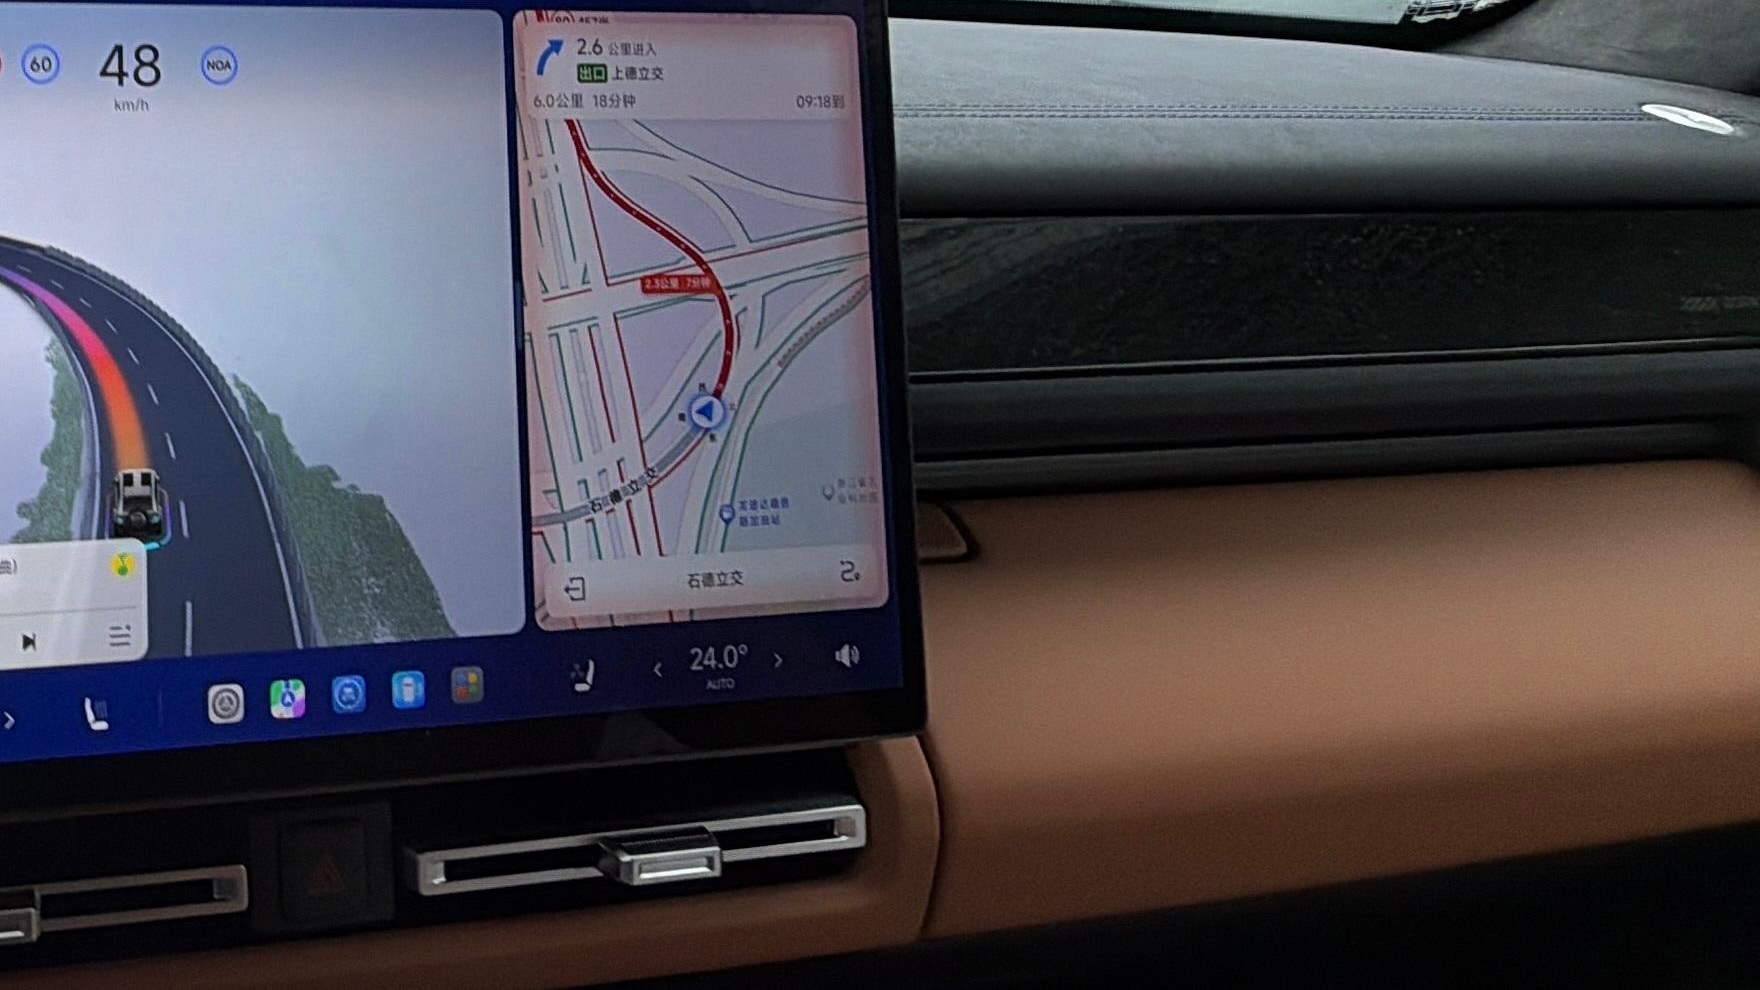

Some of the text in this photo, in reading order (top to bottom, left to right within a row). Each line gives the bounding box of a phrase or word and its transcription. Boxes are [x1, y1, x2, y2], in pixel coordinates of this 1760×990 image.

[576, 38, 657, 57] 2.6 公里进入
[29, 56, 53, 73] 60
[98, 43, 162, 87] 48
[206, 59, 232, 72] NOA
[578, 65, 664, 81] 出口 上德立交
[113, 97, 150, 114] km/h
[533, 94, 636, 109] 6.0公里 18分钟
[687, 570, 744, 590] 石德立交
[690, 644, 748, 671] 24.0°
[706, 677, 736, 690] AUTO
